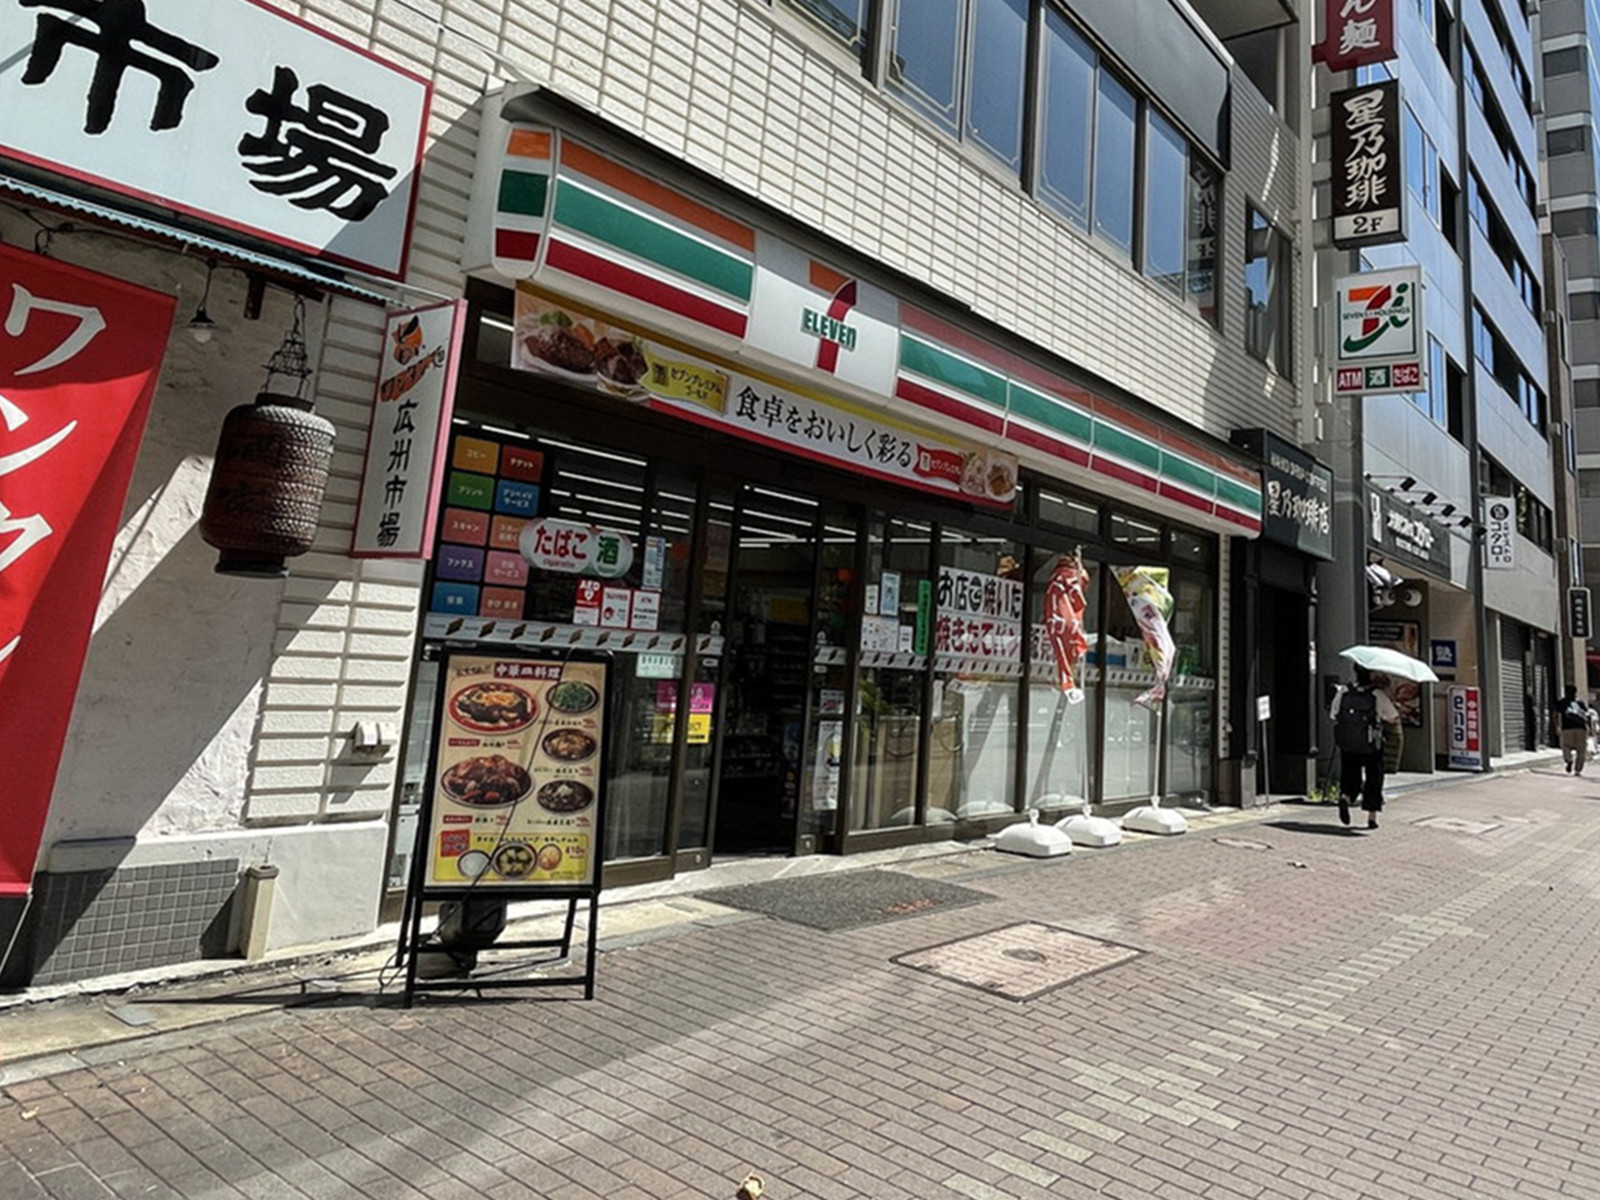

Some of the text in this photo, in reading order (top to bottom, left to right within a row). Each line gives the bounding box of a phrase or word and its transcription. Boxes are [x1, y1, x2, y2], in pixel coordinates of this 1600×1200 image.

[20, 0, 398, 222] 市場
[1343, 89, 1388, 209] 星乃珈琲
[1353, 216, 1383, 235] 2F
[1338, 366, 1419, 387] ATM 酒 たばこ
[735, 386, 912, 468] 食卓をおいしく彩る
[465, 448, 487, 460] コピー
[509, 457, 535, 469] チケット
[375, 398, 419, 548] 広州市場
[457, 485, 484, 497] プリント
[503, 497, 530, 509] サービス
[451, 520, 480, 533] スキャン
[534, 525, 588, 560] たばこ
[596, 535, 620, 566] 酒
[492, 567, 520, 579] サービス
[579, 579, 601, 591] AED
[937, 570, 1021, 619] お店で焼いた
[1453, 695, 1465, 742] ena
